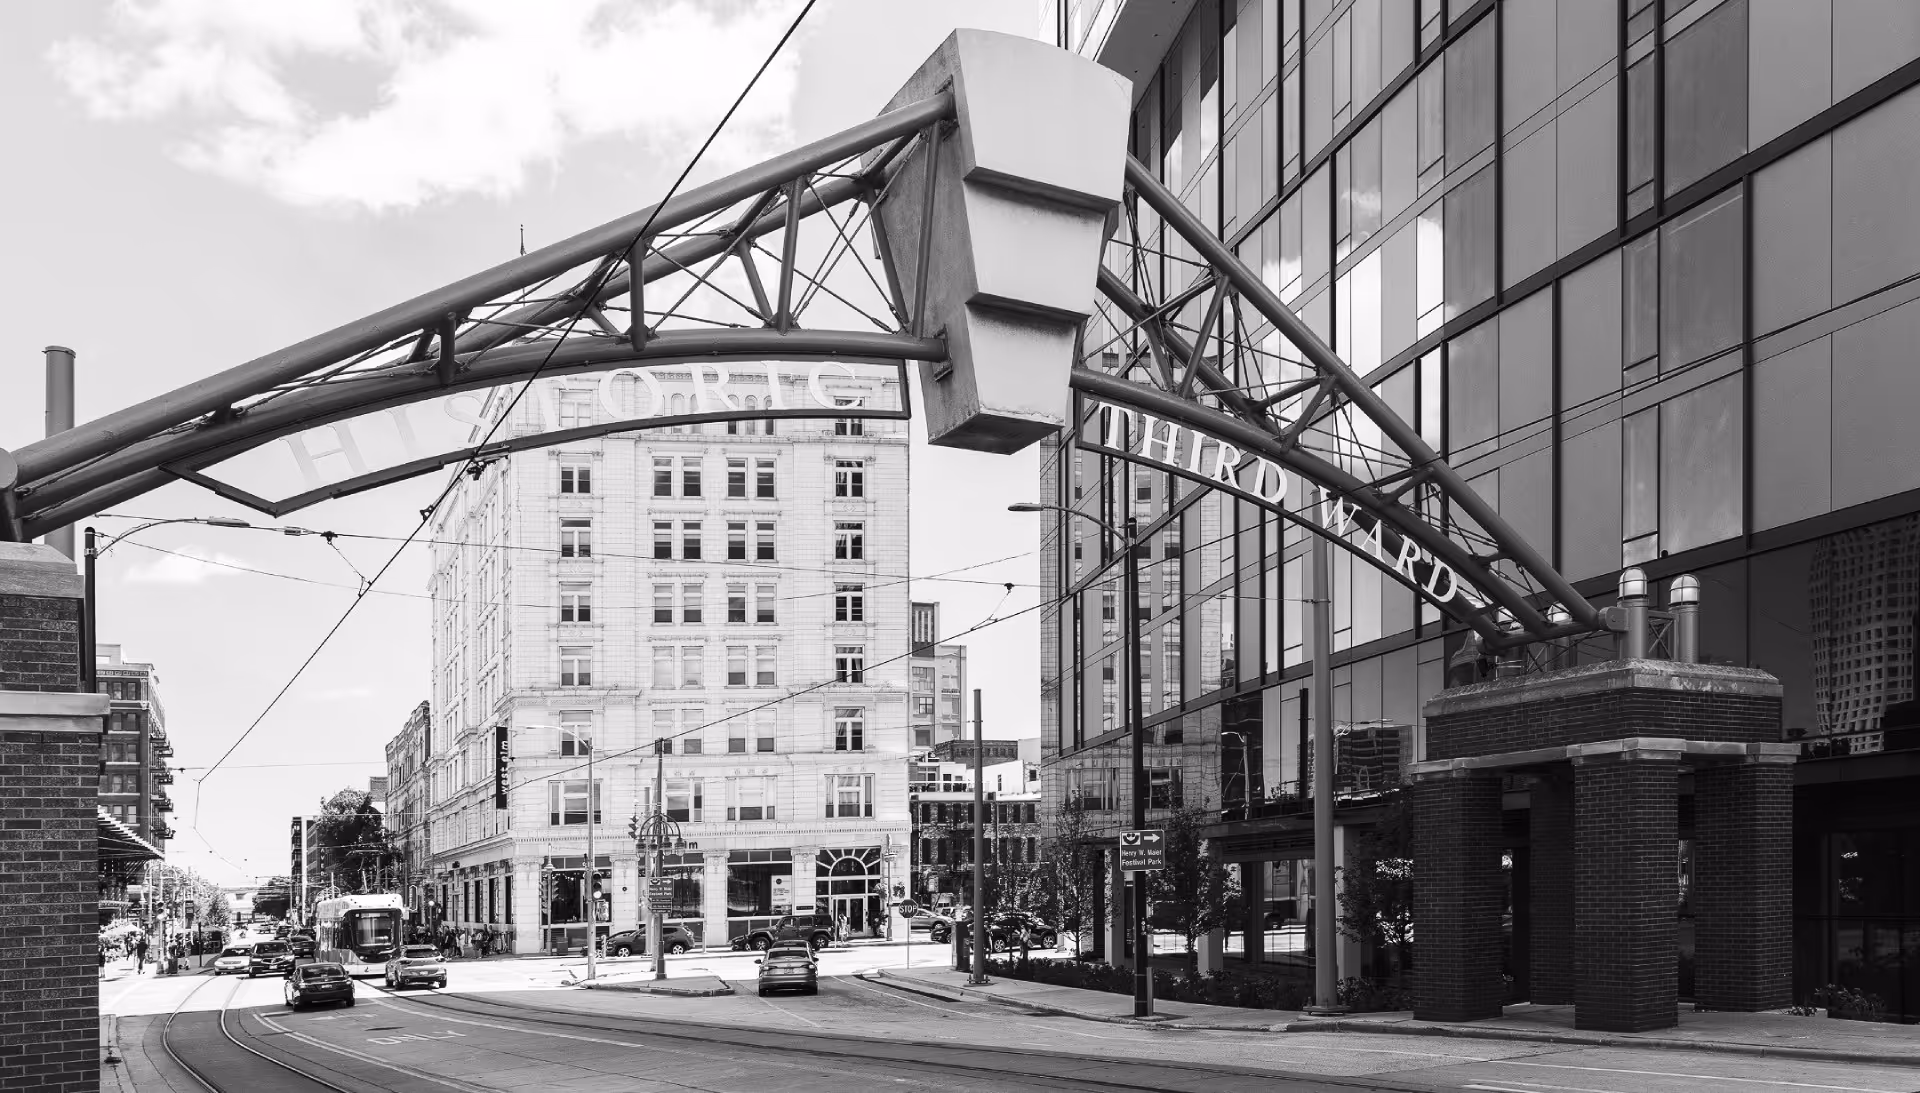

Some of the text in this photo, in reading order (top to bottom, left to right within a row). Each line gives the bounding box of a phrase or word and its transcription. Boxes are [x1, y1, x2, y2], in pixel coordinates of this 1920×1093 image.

[1099, 401, 1458, 603] THIRD WARD
[500, 740, 508, 795] west elm
[1121, 849, 1137, 858] Henry
[1121, 858, 1146, 866] Festival
[900, 905, 916, 913] STOP
[366, 1030, 467, 1045] ONLY
